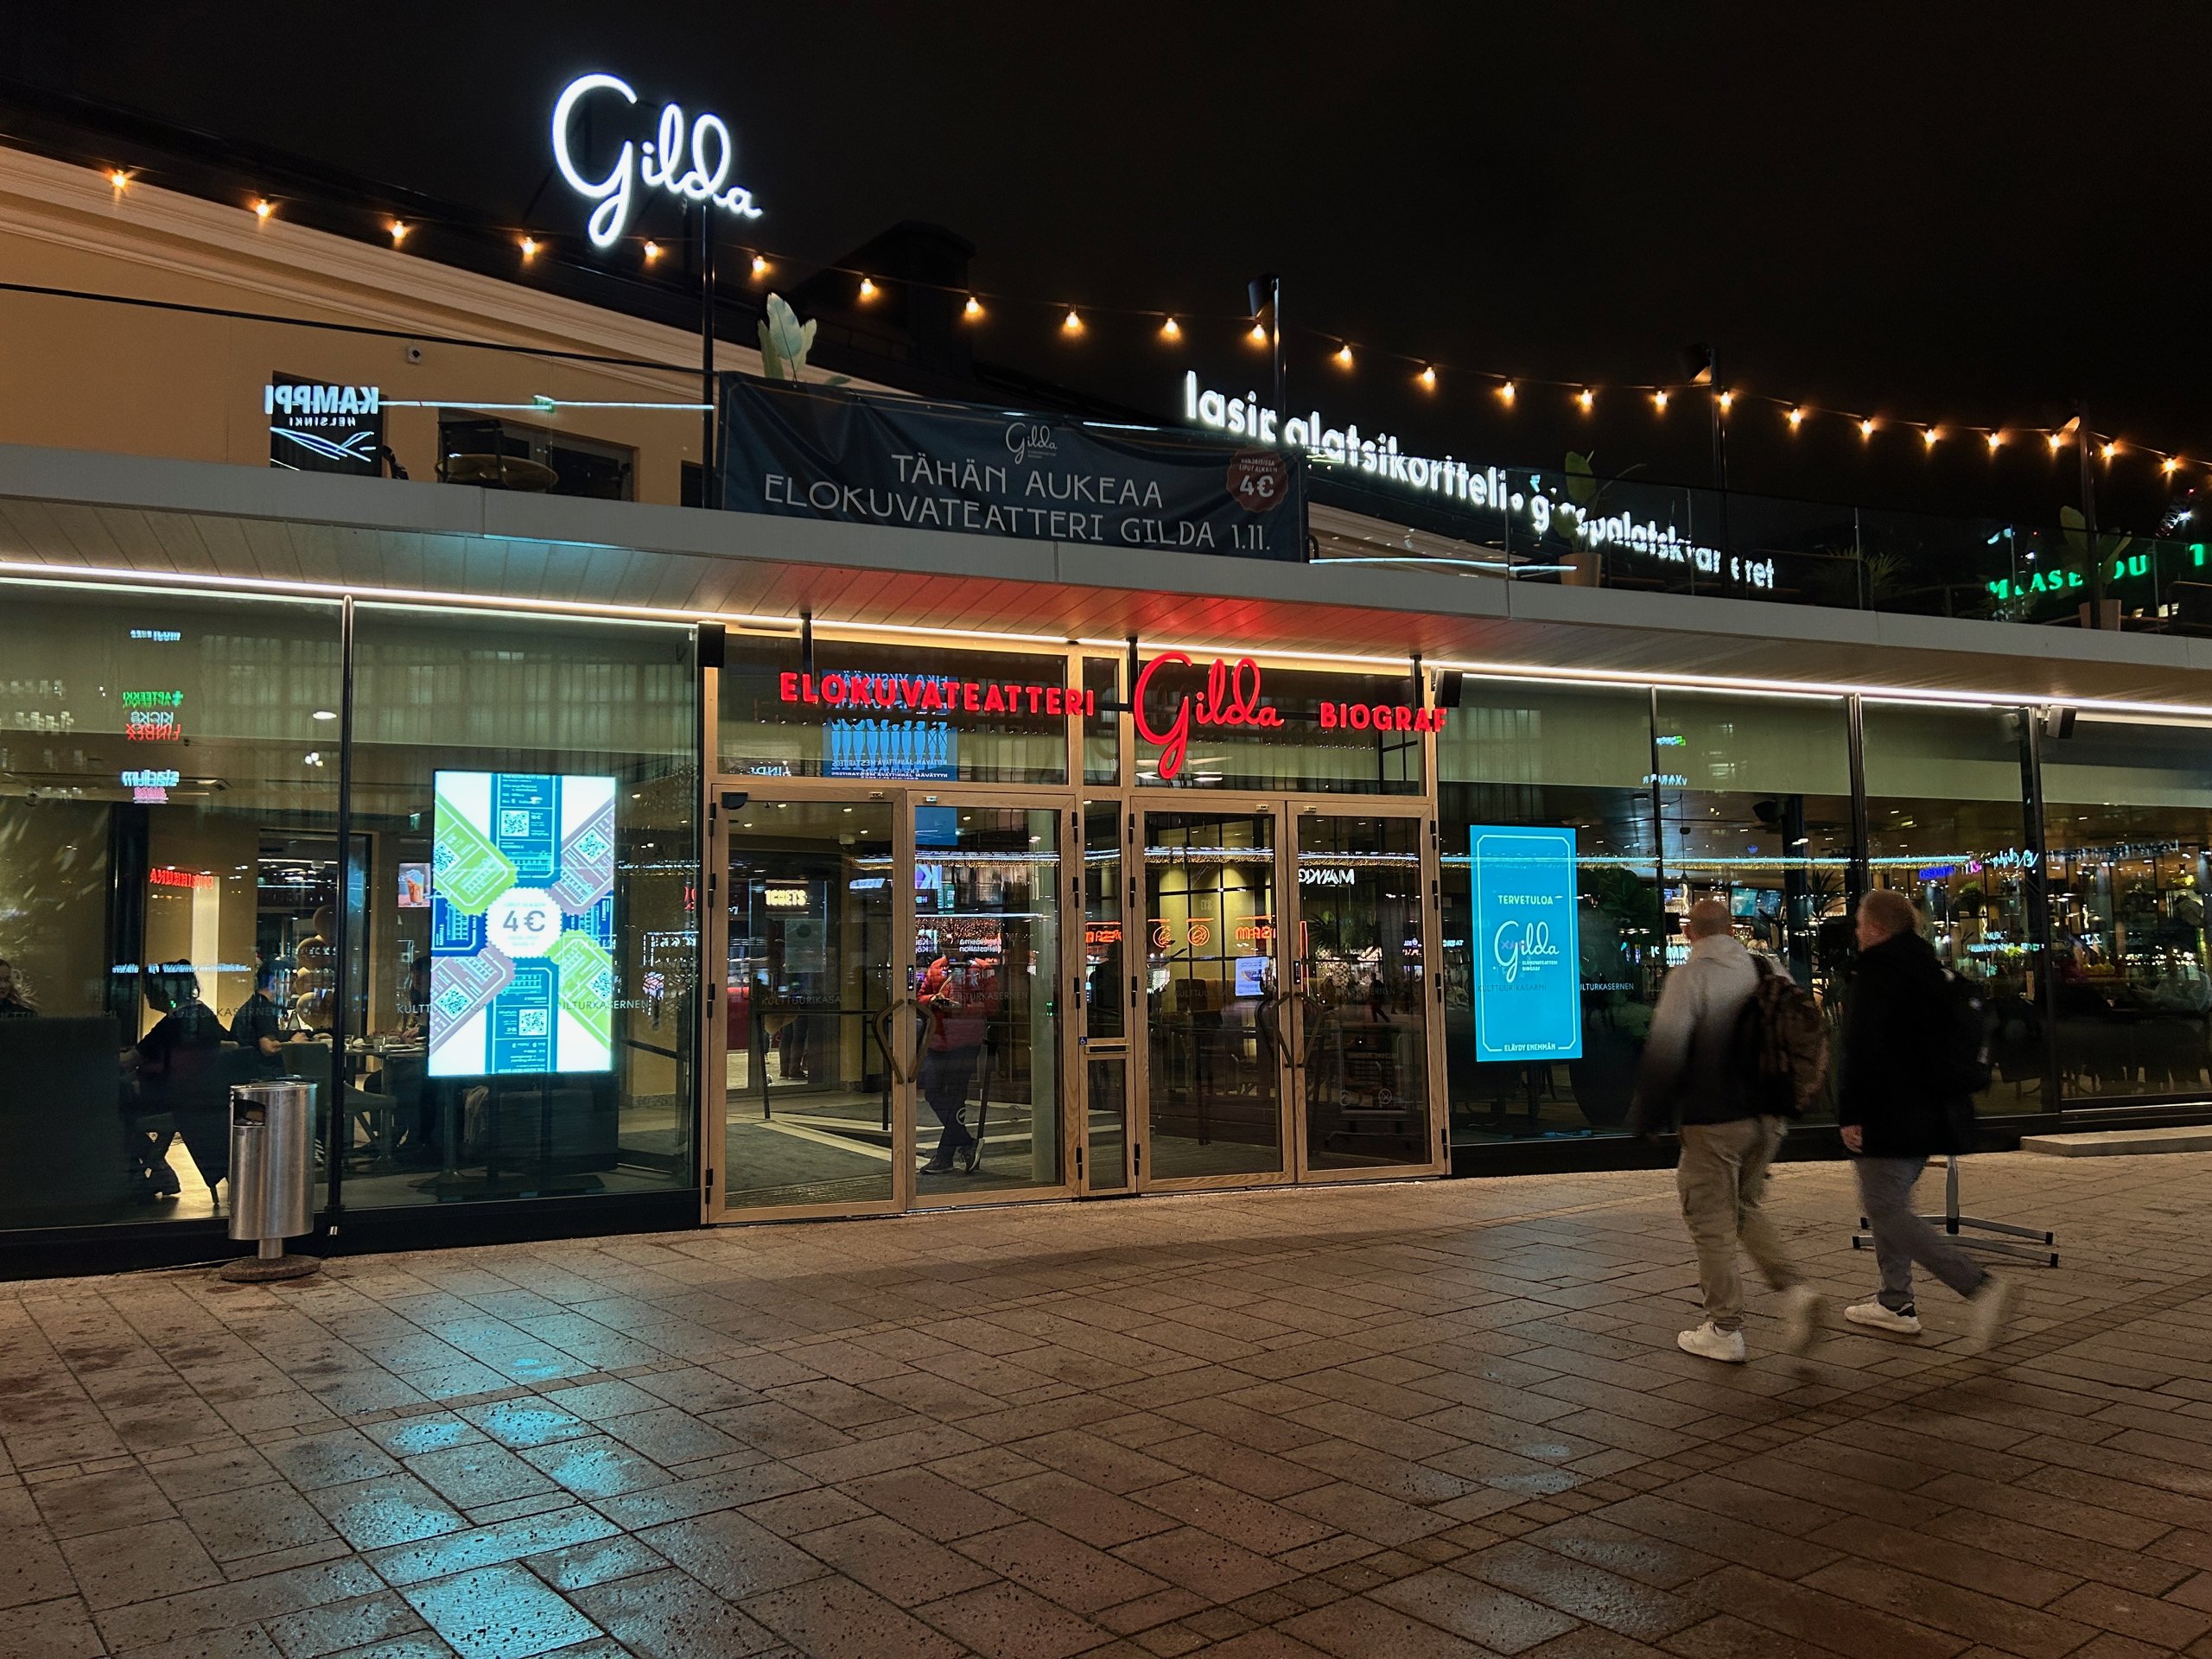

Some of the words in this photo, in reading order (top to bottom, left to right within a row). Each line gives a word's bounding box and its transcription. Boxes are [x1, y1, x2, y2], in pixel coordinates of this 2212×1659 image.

[552, 73, 763, 248] Gilda
[1006, 422, 1058, 465] Gilda
[891, 452, 1006, 493] TÄHÄN
[1025, 470, 1163, 509] AUKEAA
[765, 474, 1104, 541] ELOKUVATEATTERI
[1120, 518, 1216, 548] GILDA
[1231, 524, 1271, 550] 1.11.
[779, 671, 1095, 717] ELOKUVATEATTERI
[1134, 652, 1286, 779] Gilda
[1319, 701, 1447, 734] BIOGRAF
[1497, 894, 1554, 906] TERVETULOA
[1494, 920, 1560, 983] Gilda
[1503, 1043, 1526, 1052] ELÄYDY
[1526, 1042, 1556, 1051] ENEMMÄN
